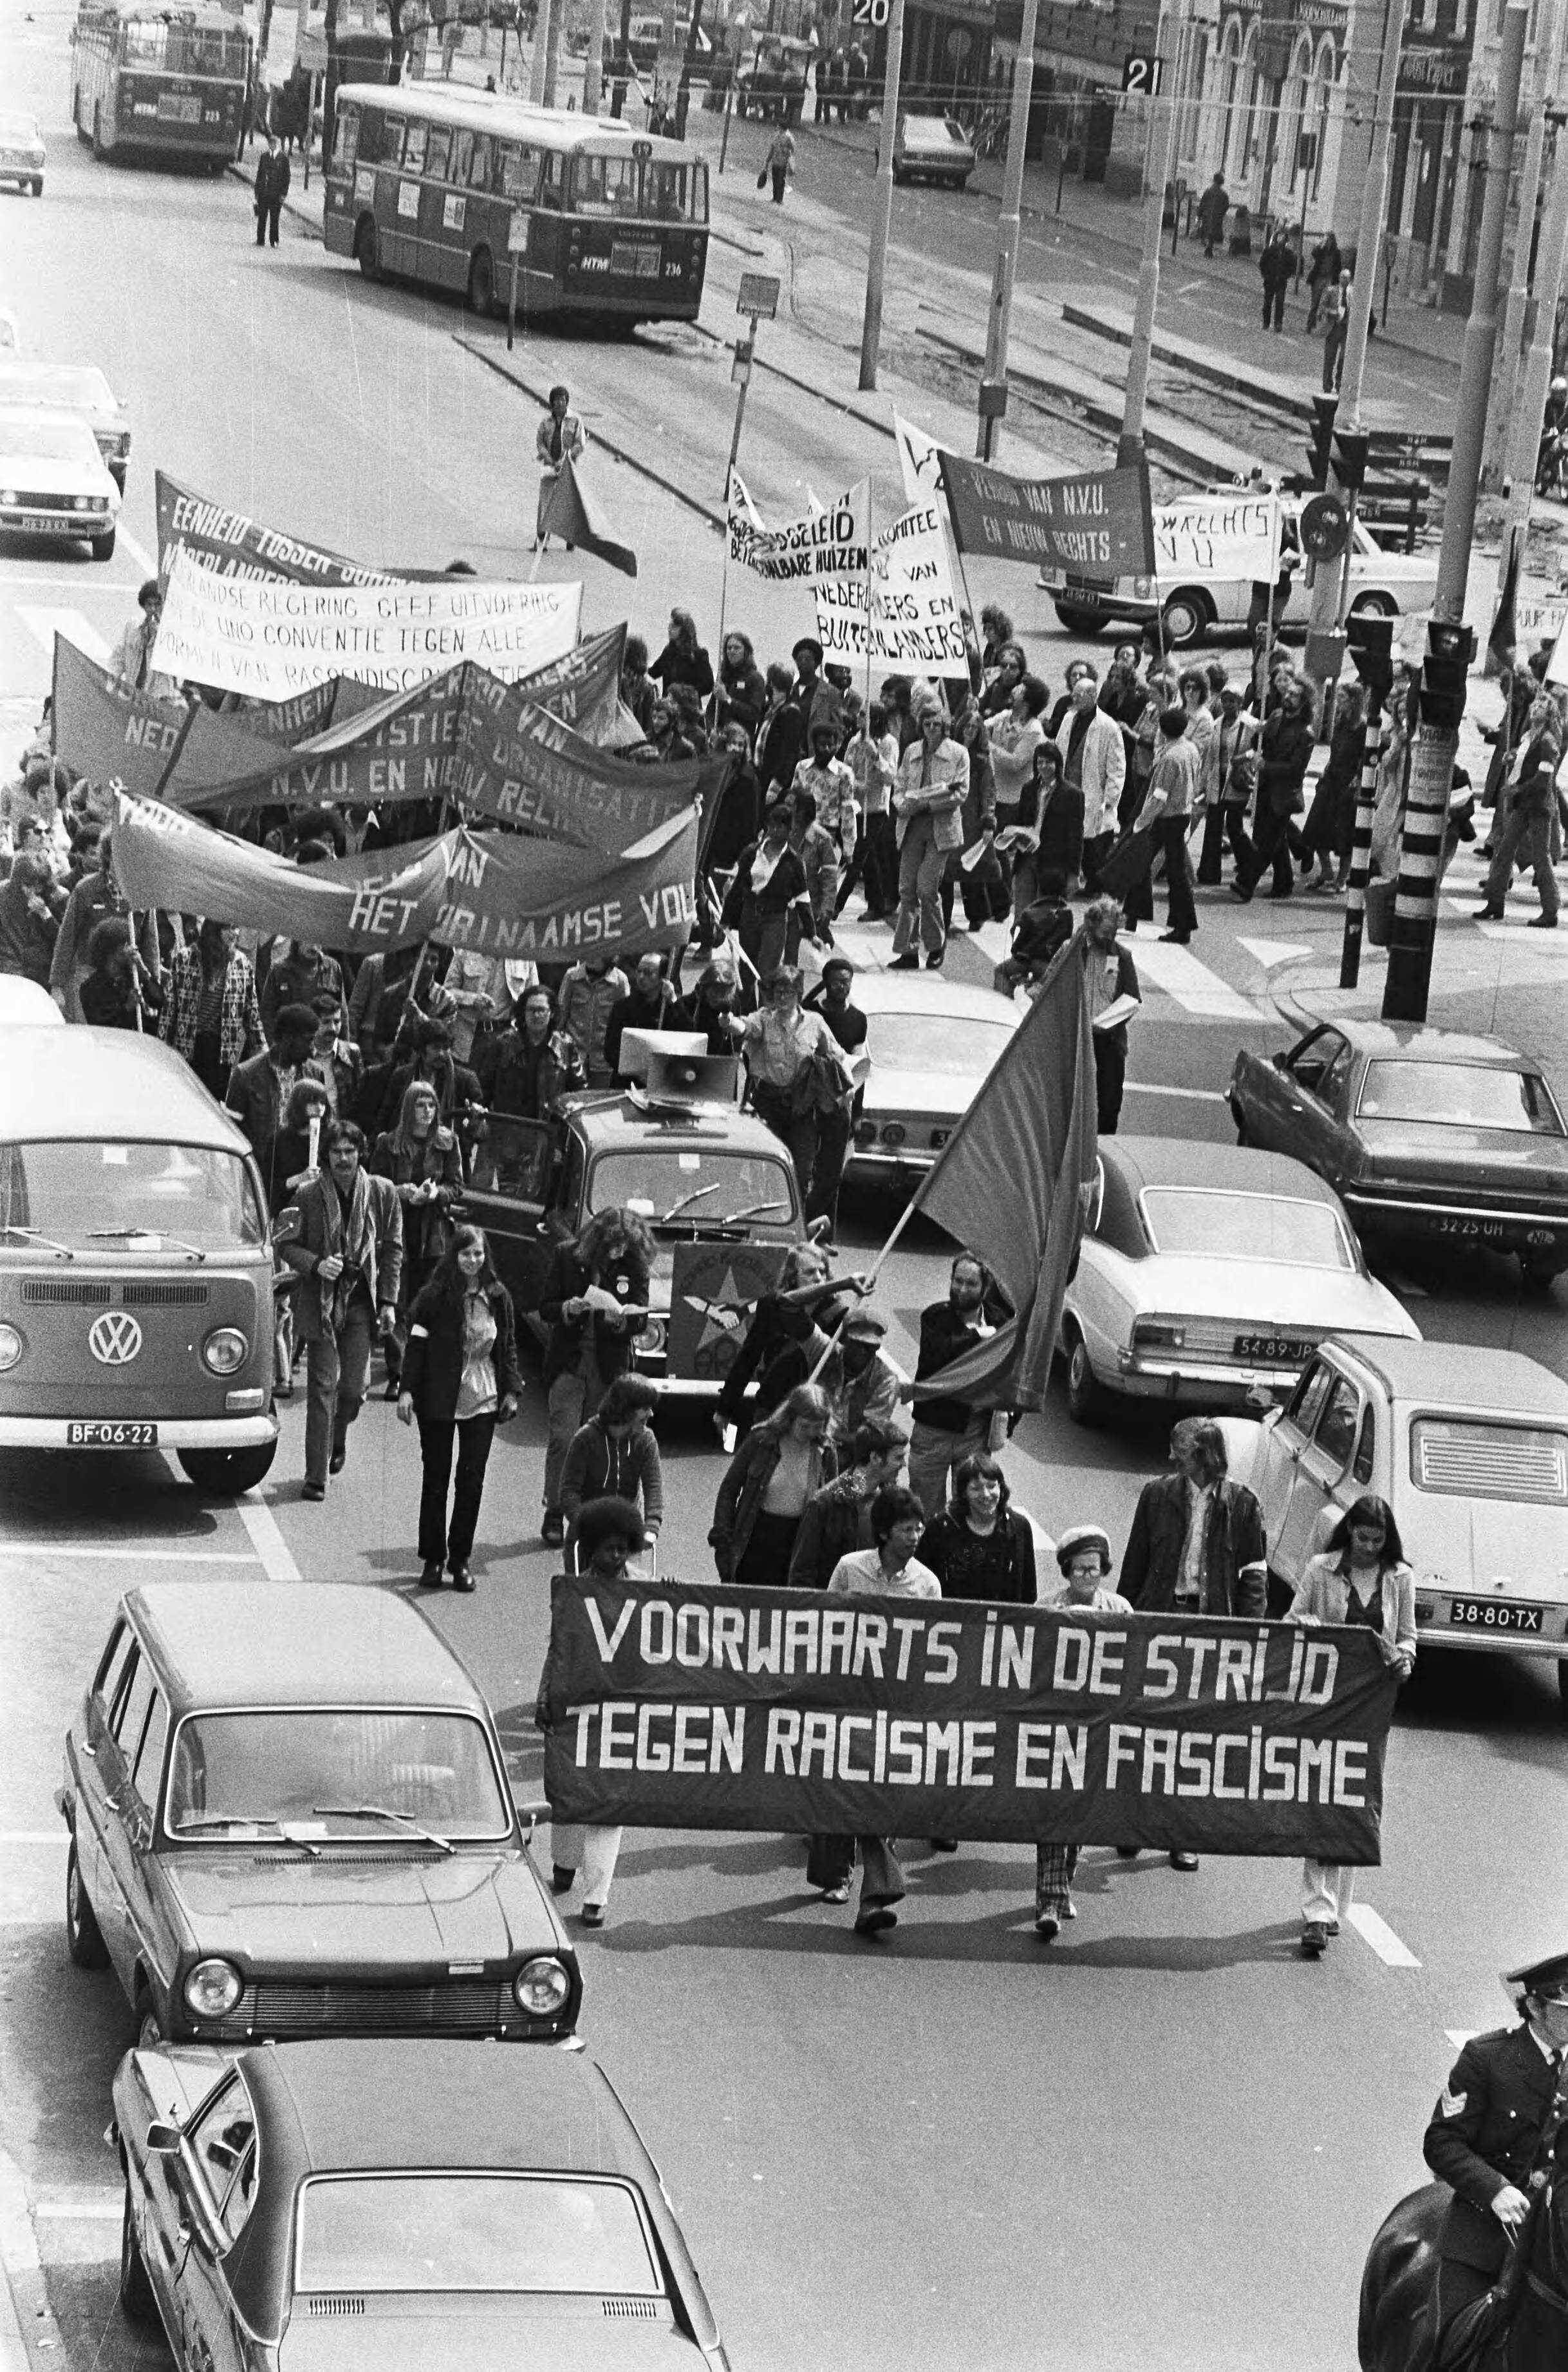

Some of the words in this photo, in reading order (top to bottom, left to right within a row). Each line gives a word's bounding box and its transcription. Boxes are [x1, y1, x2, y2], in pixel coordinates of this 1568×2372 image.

[854, 0, 888, 26] 20
[1127, 58, 1160, 95] 21
[581, 256, 610, 272] HTM
[1022, 483, 1054, 516] VAN
[1062, 482, 1110, 516] N.V.U.
[173, 496, 254, 546] EENHEID
[982, 514, 1004, 545] EN
[1006, 518, 1050, 554] NIEUW
[1052, 530, 1111, 563] RECHTS
[902, 560, 938, 582] VAN
[814, 581, 919, 622] NEDERLNDERS
[928, 595, 955, 616] EN
[263, 623, 386, 655] CONVENTIE
[397, 625, 465, 655] TEGEN
[477, 625, 528, 653] ALLE
[516, 702, 572, 753] VAN
[369, 758, 407, 794] EN
[349, 891, 420, 936] HET
[72, 1424, 153, 1445] BF-06-22
[1452, 1601, 1538, 1630] 38-80-TX
[584, 1596, 963, 1684] VOORWAARTS
[1052, 1628, 1128, 1697] DE
[566, 1701, 747, 1774] TEGEN
[1015, 1721, 1088, 1791] EN
